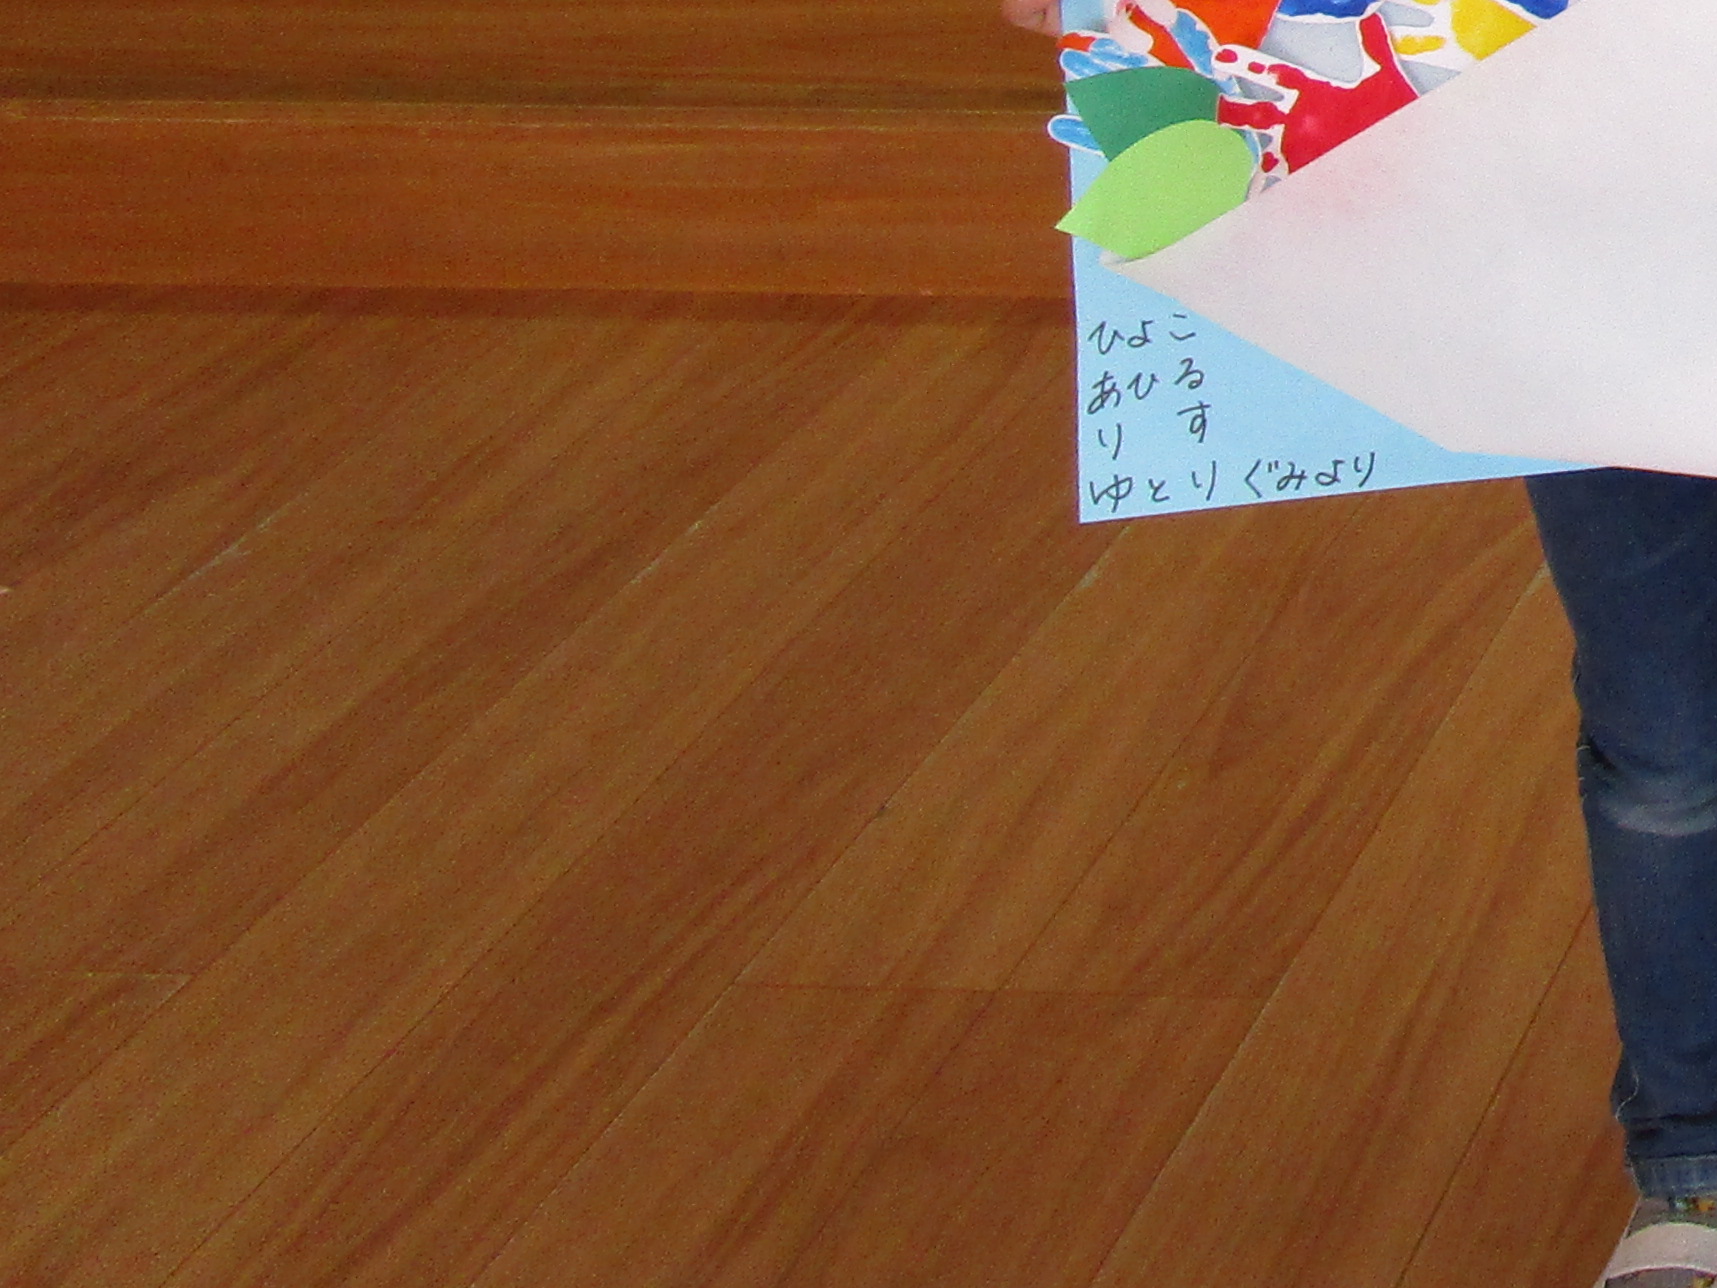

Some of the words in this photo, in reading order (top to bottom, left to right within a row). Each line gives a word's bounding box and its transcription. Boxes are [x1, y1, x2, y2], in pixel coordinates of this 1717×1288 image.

[1087, 314, 1196, 355] ひよこ
[1087, 357, 1205, 415] あひる
